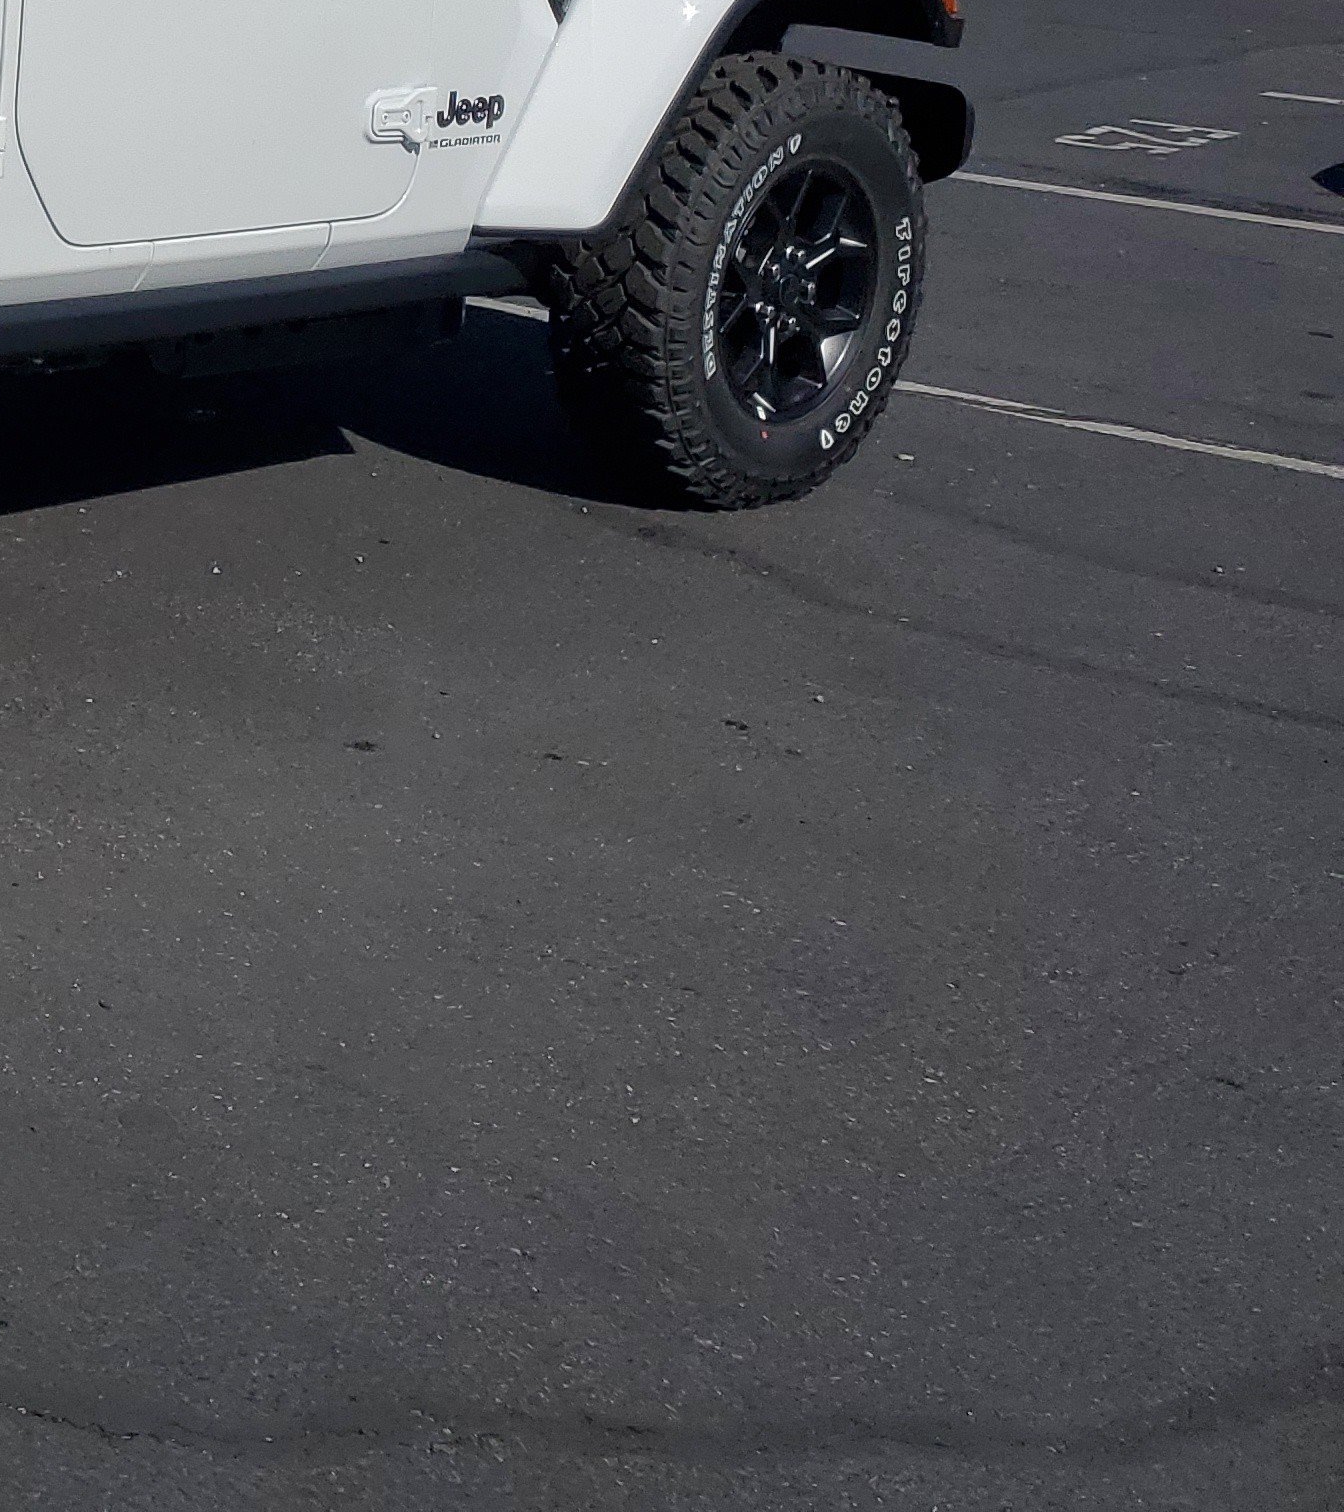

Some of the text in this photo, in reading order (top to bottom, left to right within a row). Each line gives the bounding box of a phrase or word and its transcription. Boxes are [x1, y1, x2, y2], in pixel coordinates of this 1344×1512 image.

[436, 90, 505, 129] Jeep
[439, 133, 501, 148] GLADIATOR
[702, 144, 785, 380] DESTINATION
